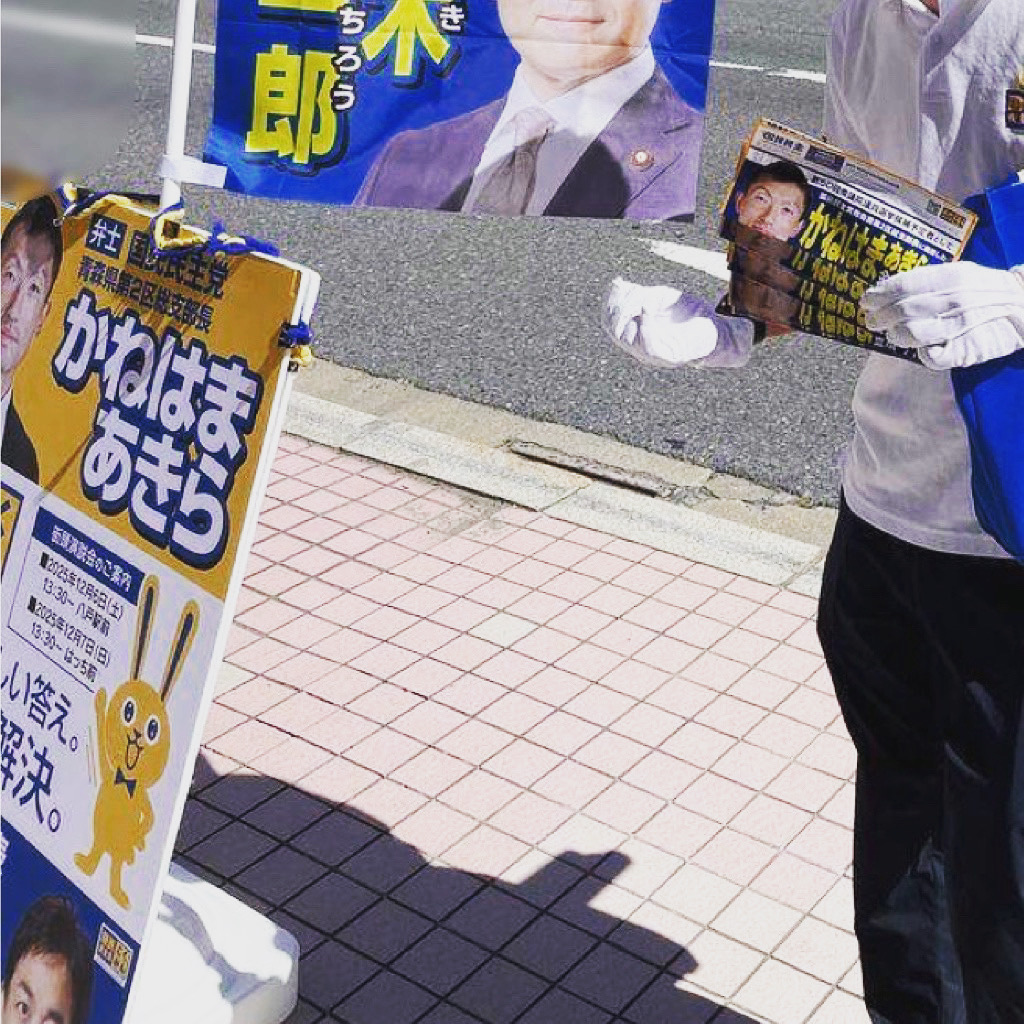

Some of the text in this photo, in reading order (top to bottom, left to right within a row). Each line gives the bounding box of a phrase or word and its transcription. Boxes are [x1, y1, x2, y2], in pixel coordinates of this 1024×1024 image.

[54, 292, 258, 461] かねはま
[83, 407, 230, 556] あきら
